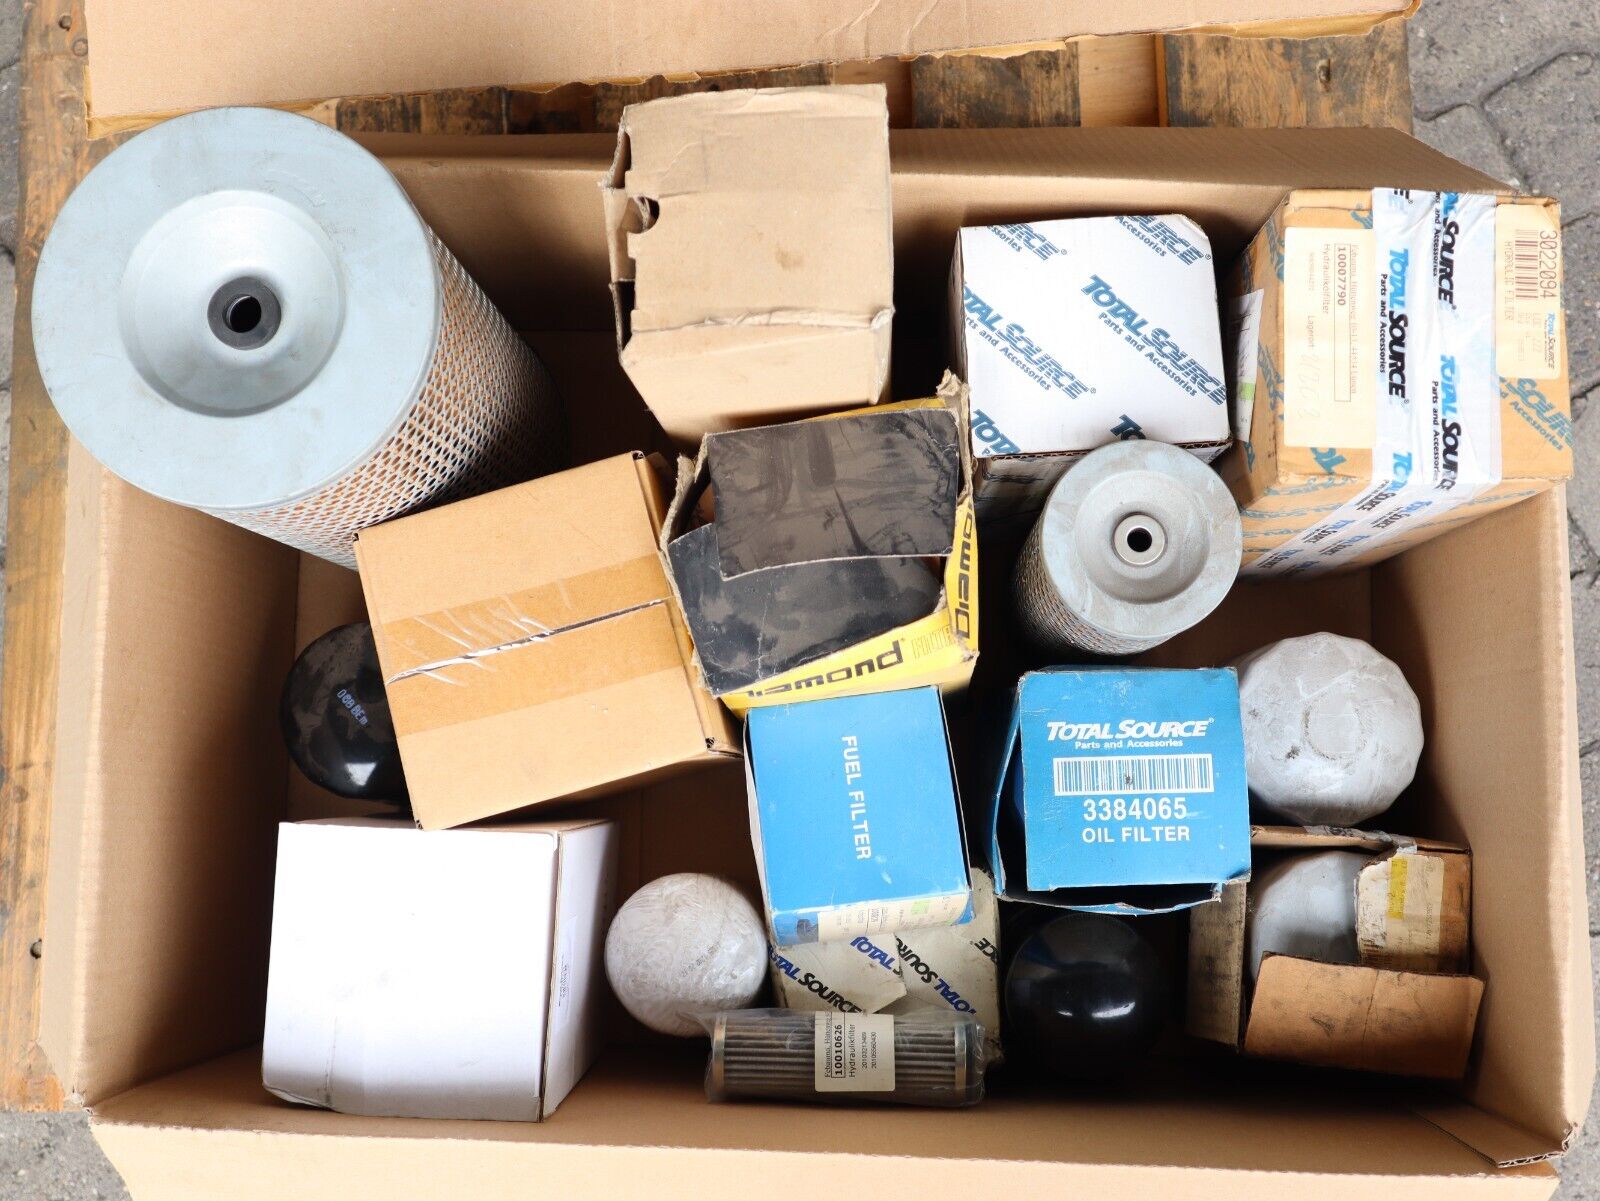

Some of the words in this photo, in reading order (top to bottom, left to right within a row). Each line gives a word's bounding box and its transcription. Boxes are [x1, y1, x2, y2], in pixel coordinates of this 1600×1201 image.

[1336, 246, 1347, 306] 10007790
[1380, 273, 1388, 296] Parts
[1389, 248, 1409, 309] TOTAL
[1438, 217, 1460, 305] SOURCE
[1540, 230, 1558, 300] 3022094
[1380, 300, 1388, 318] and
[964, 285, 1004, 333] OTAL
[995, 323, 1089, 400] SOURCE
[979, 330, 1000, 347] and
[999, 346, 1052, 391] Accessories
[1081, 274, 1149, 337] TOTAL
[1141, 327, 1227, 405] SOURCE
[1098, 312, 1124, 335] Parts
[1124, 335, 1146, 352] and
[1144, 352, 1197, 397] Accessories
[1379, 321, 1388, 373] Accessories
[1388, 310, 1409, 399] SOURCE
[1431, 380, 1439, 404] Parts
[1440, 354, 1458, 415] TOTAL
[1432, 408, 1440, 425] and
[1509, 400, 1563, 450] Accessories
[1046, 721, 1114, 741] TOTAL
[1115, 719, 1210, 739] SOURCE
[1075, 741, 1100, 750] Parts
[1103, 740, 1123, 749] and
[1126, 738, 1184, 748] Accessories
[841, 735, 862, 786] FUEL
[848, 790, 872, 861] FILTER
[1082, 827, 1115, 843] OIL
[1121, 826, 1191, 843] FILTER
[1083, 797, 1187, 821] 3384065
[834, 1024, 843, 1076] 10010626
[848, 1024, 857, 1078] Hydraulikfilter
